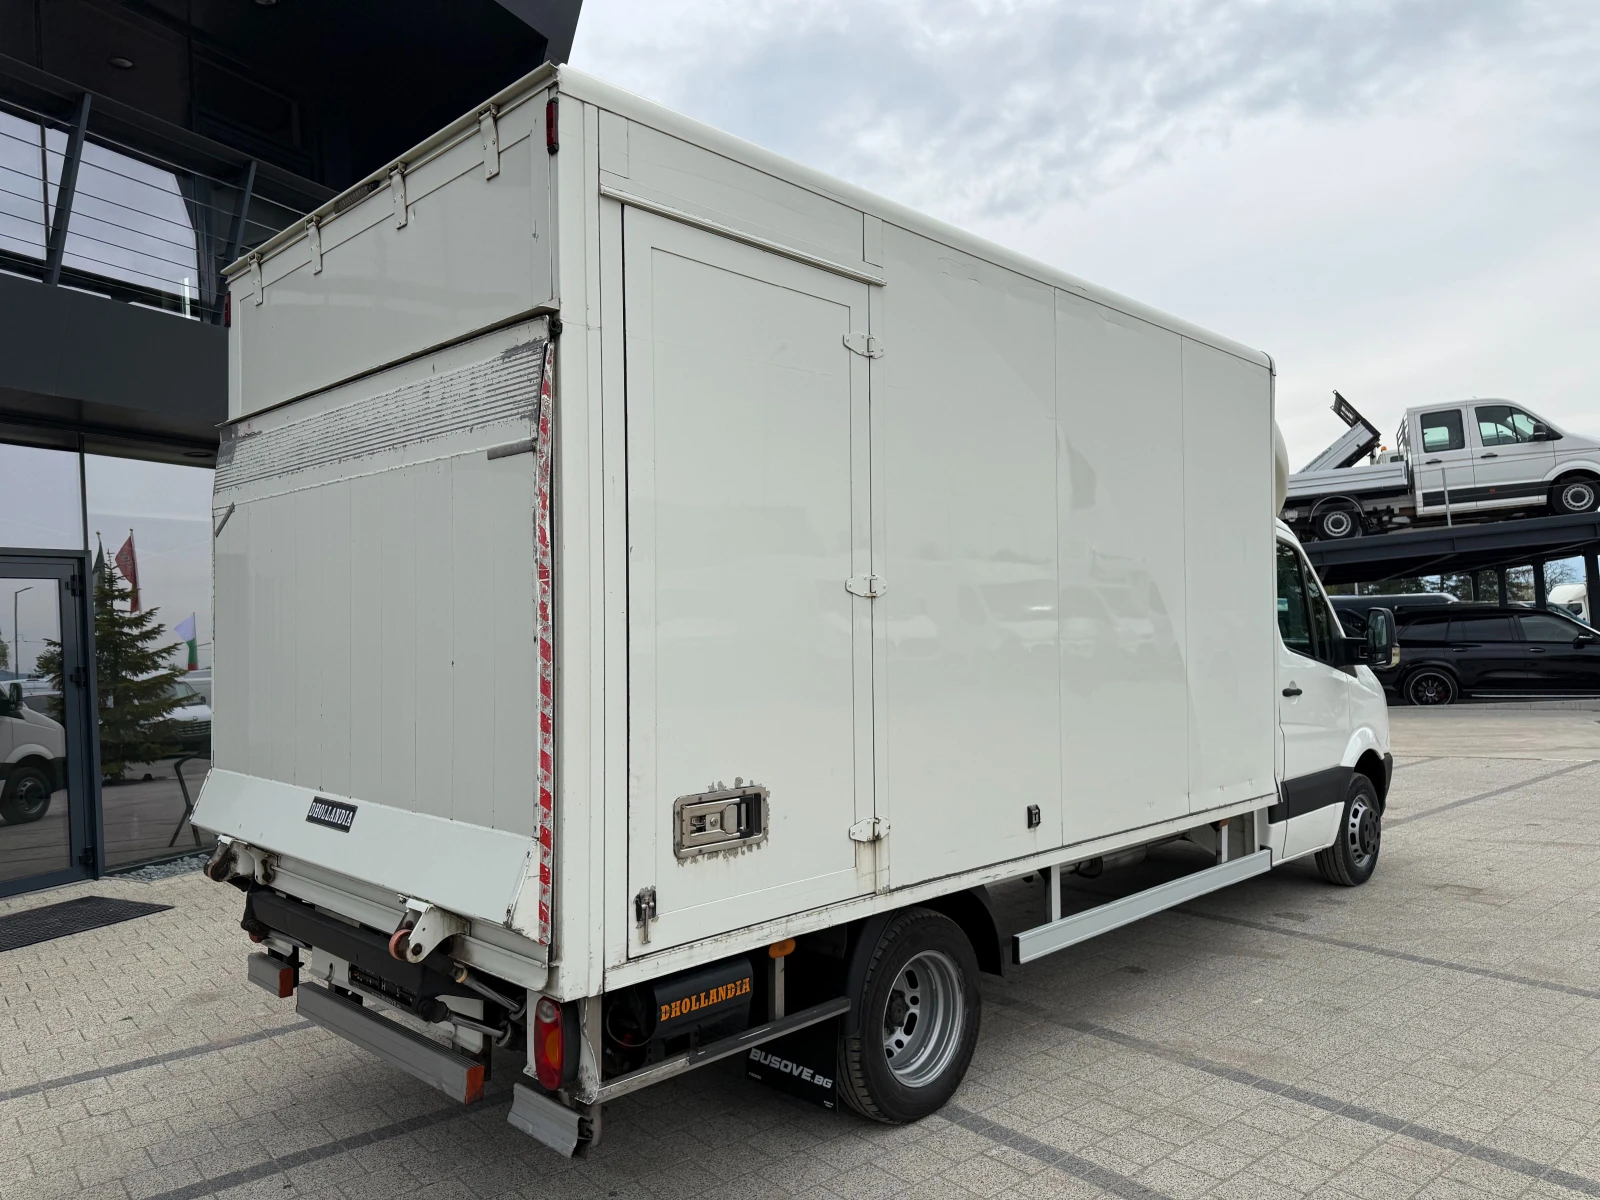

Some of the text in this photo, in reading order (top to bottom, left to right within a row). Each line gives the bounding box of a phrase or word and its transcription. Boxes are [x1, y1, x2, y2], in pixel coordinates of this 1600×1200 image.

[308, 802, 354, 827] DHOLLANDIA
[660, 977, 751, 1021] DHOLLANDIA
[749, 1047, 833, 1089] BUSOVE.BG
